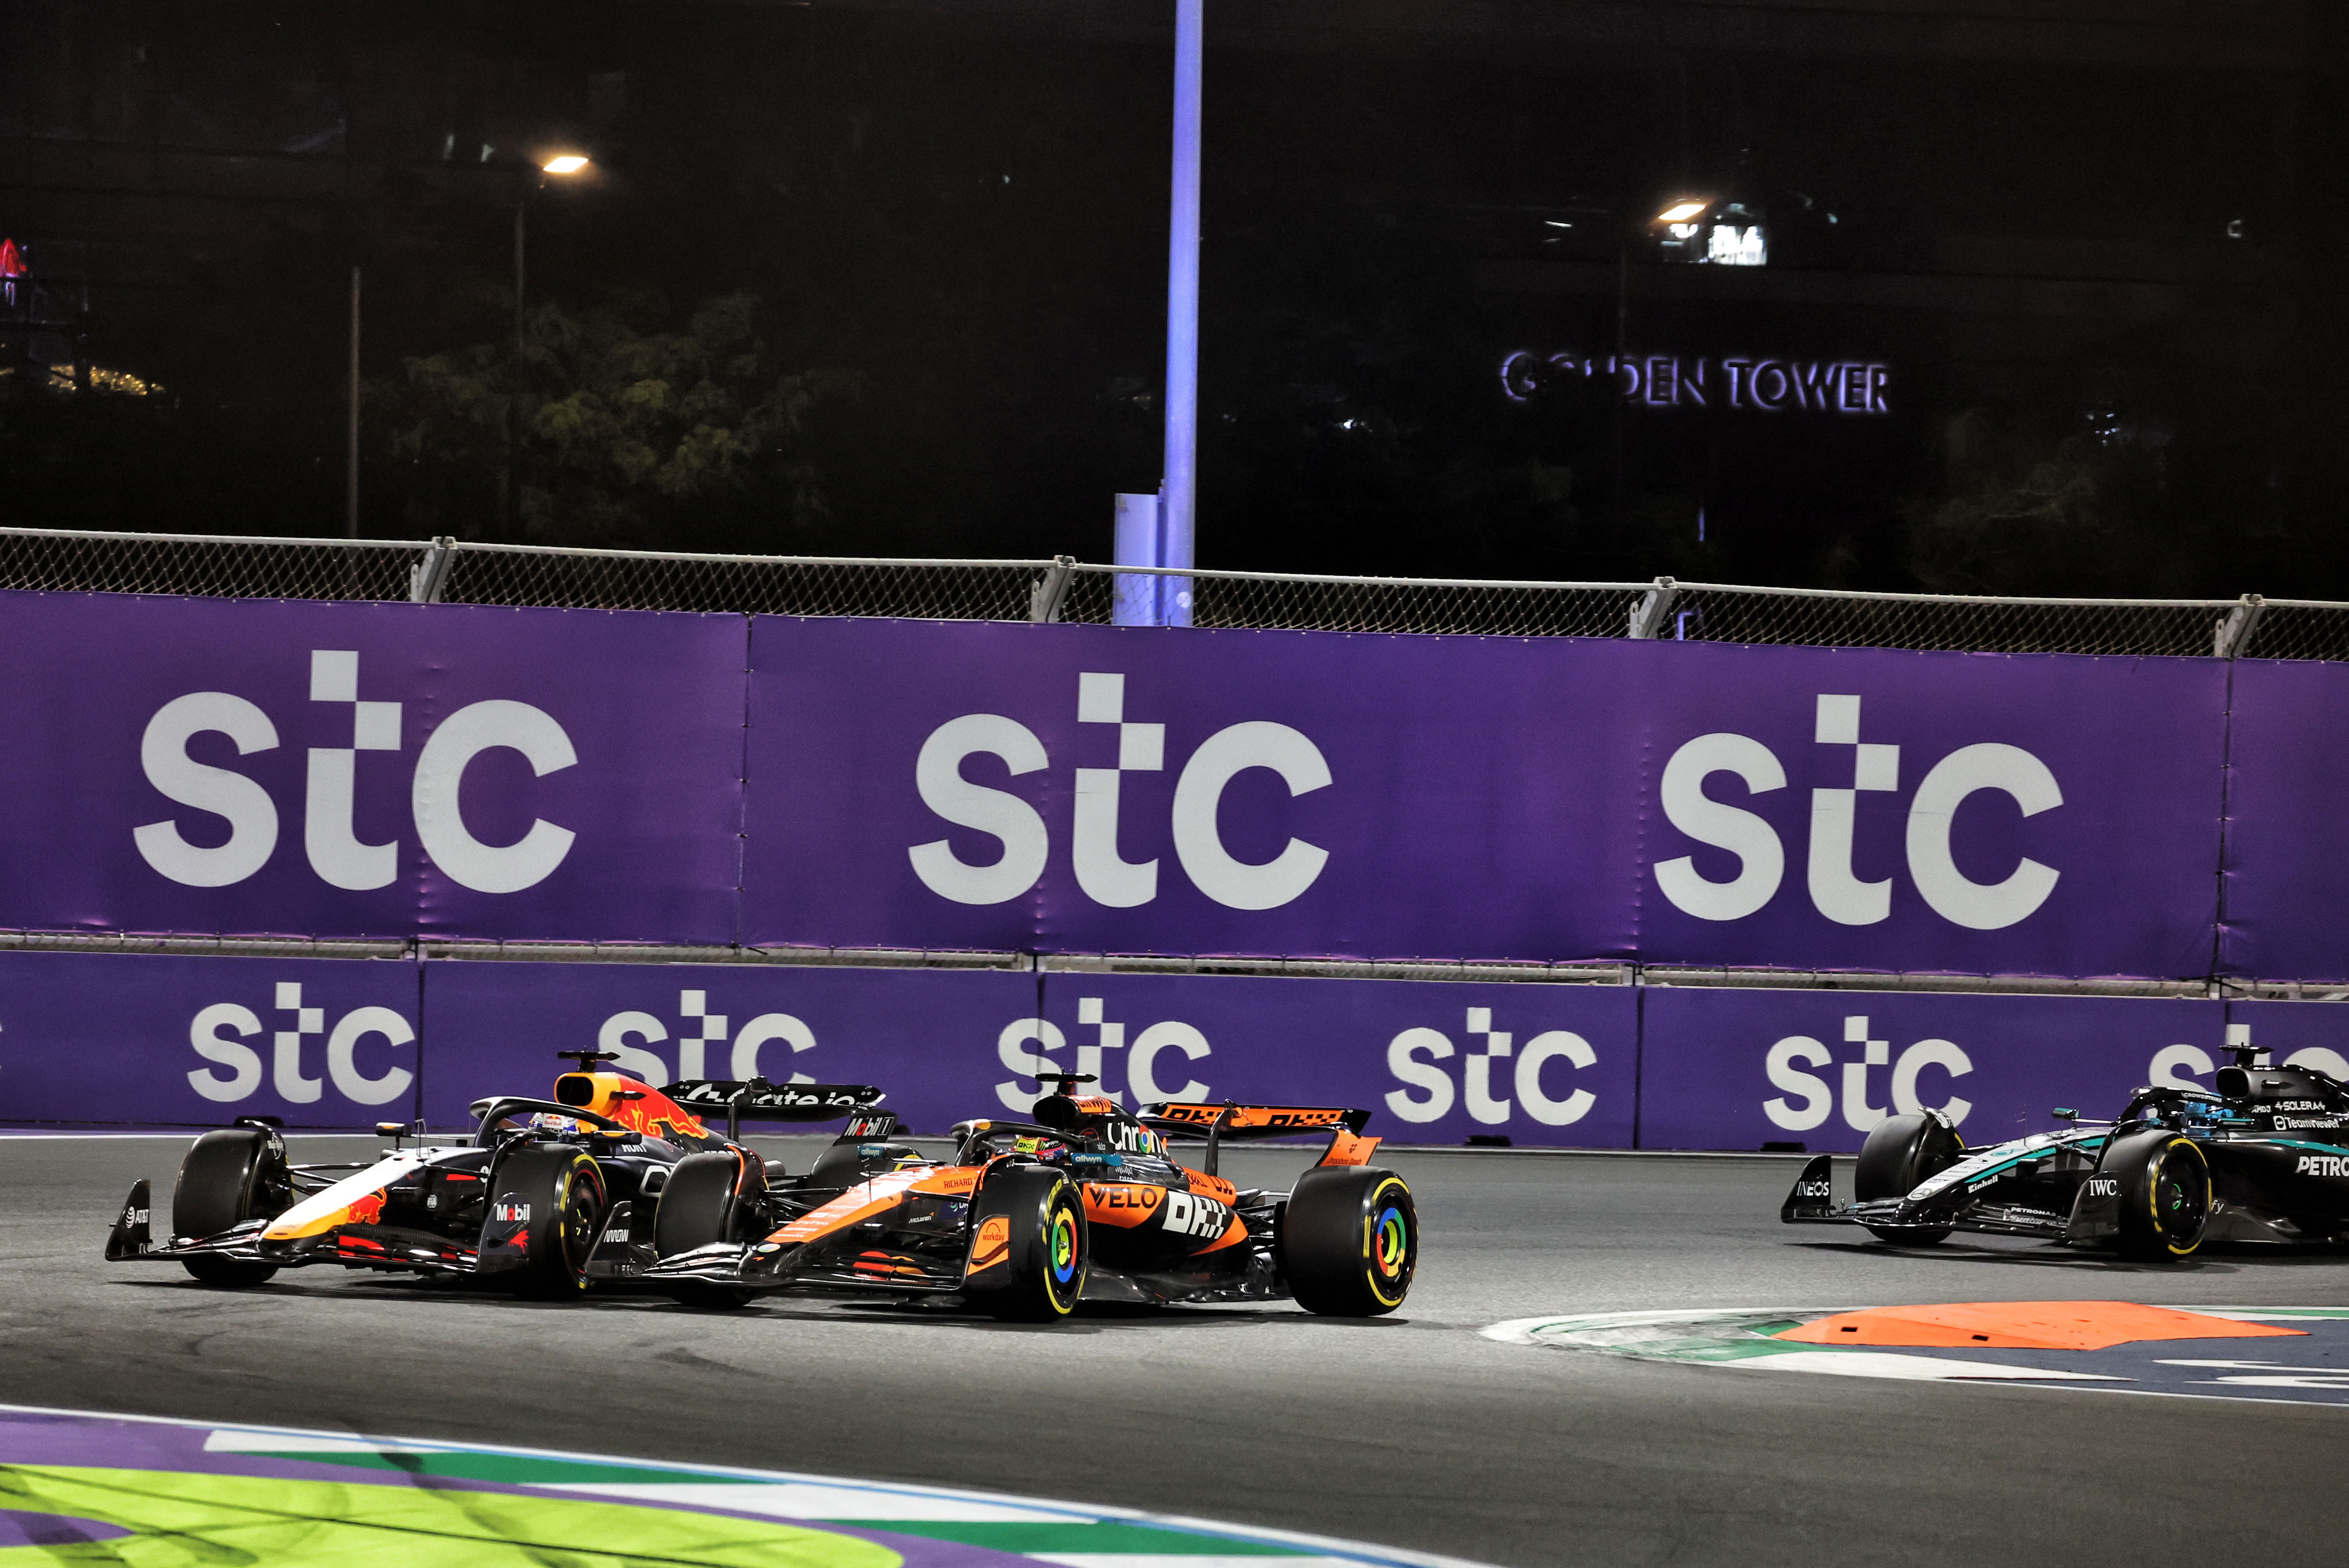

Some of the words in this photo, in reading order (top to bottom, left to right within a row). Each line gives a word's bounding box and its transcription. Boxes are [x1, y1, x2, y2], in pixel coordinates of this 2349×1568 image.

[1501, 352, 1707, 406] GDEN
[1725, 360, 1888, 412] TOWER
[133, 650, 578, 893] stc
[908, 672, 1332, 910] stc
[1654, 694, 2064, 930] stc
[187, 982, 415, 1105] stc
[598, 990, 816, 1091] stc
[996, 997, 1211, 1114] stc
[1384, 1007, 1597, 1126] stc
[1763, 1016, 1973, 1132] stc
[2184, 1092, 2223, 1103] CROWDSTRIKE
[2283, 1101, 2320, 1111] SOLERA
[844, 1117, 883, 1136] Mobil
[1075, 1155, 1102, 1163] allwyn
[944, 1178, 973, 1189] RICHARD
[1796, 1180, 1829, 1197] INEOS
[1968, 1174, 1998, 1193] Einhell
[2089, 1180, 2117, 1196] IWC
[1088, 1187, 1157, 1208] VELO
[135, 1209, 149, 1224] AT&T
[497, 1204, 530, 1221] Mobil
[908, 1216, 932, 1224] McLaren
[1162, 1190, 1227, 1240] OKX
[982, 1232, 1005, 1243] workday
